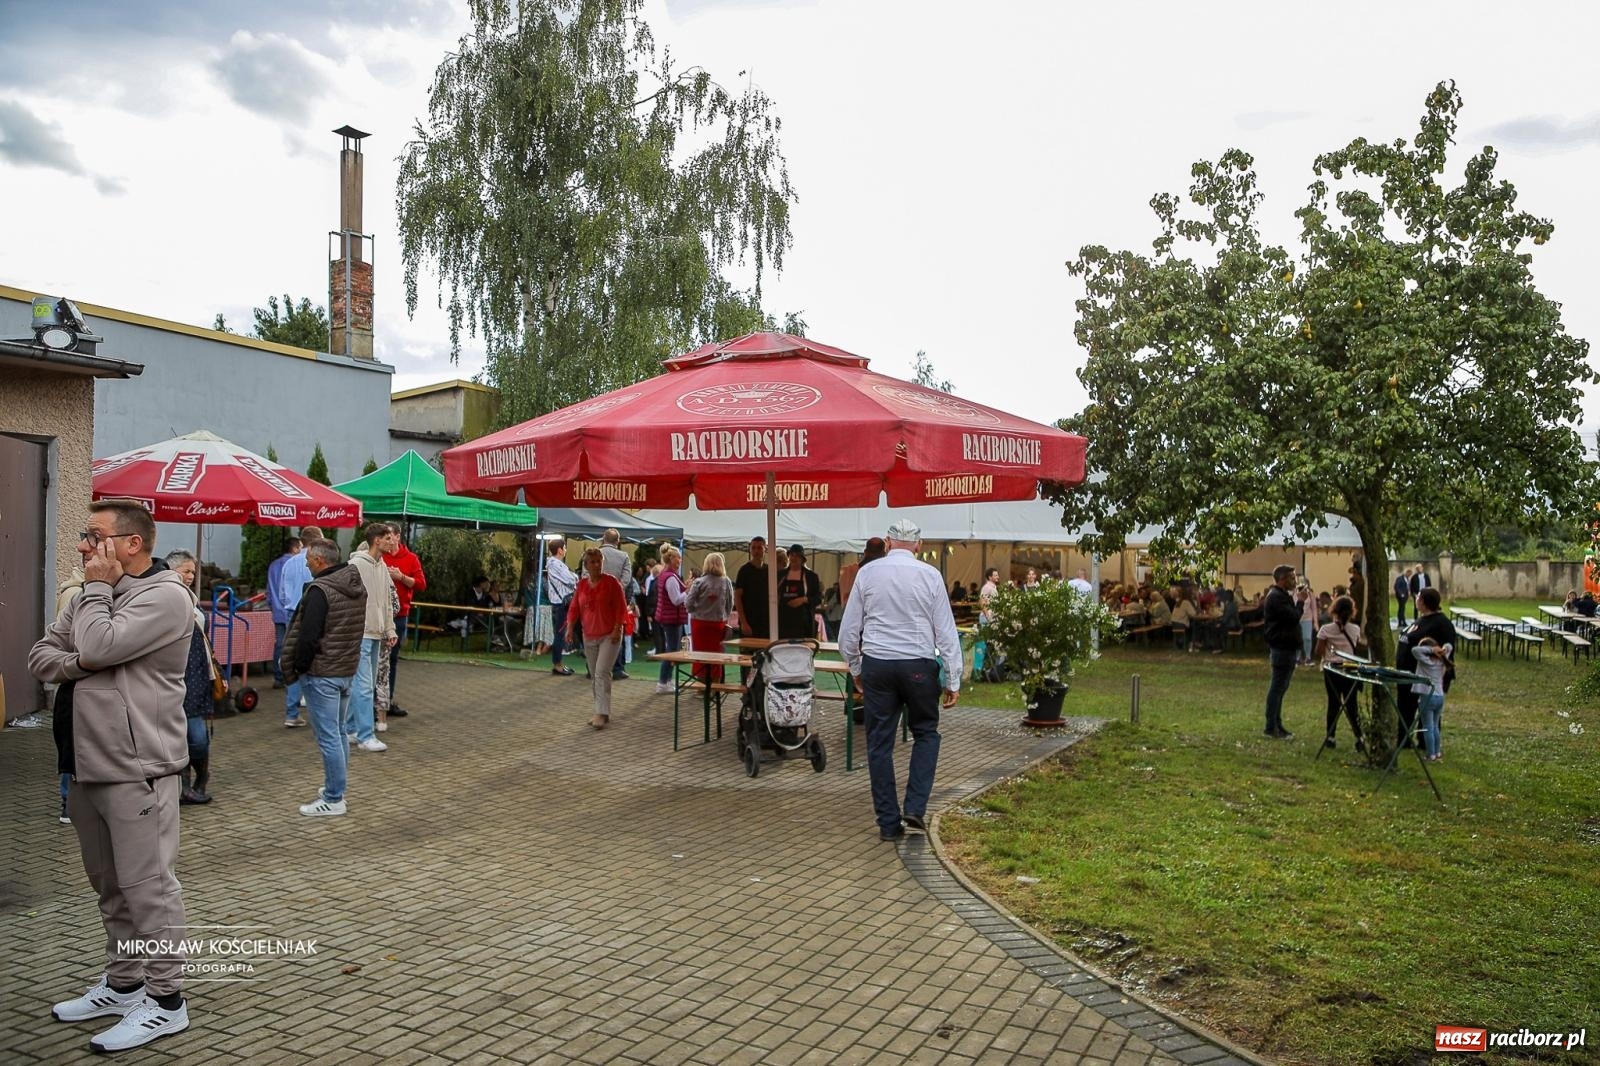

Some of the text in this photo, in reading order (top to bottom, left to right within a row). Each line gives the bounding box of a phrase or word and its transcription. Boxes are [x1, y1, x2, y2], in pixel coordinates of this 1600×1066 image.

[476, 443, 537, 477] RACIBORSKIE
[671, 428, 808, 461] RACIBORSKIE
[963, 433, 1042, 466] RACIBORSKIE
[165, 455, 200, 490] WARKA
[186, 501, 230, 516] Classic
[260, 505, 294, 516] WARKA
[317, 506, 346, 520] Classic
